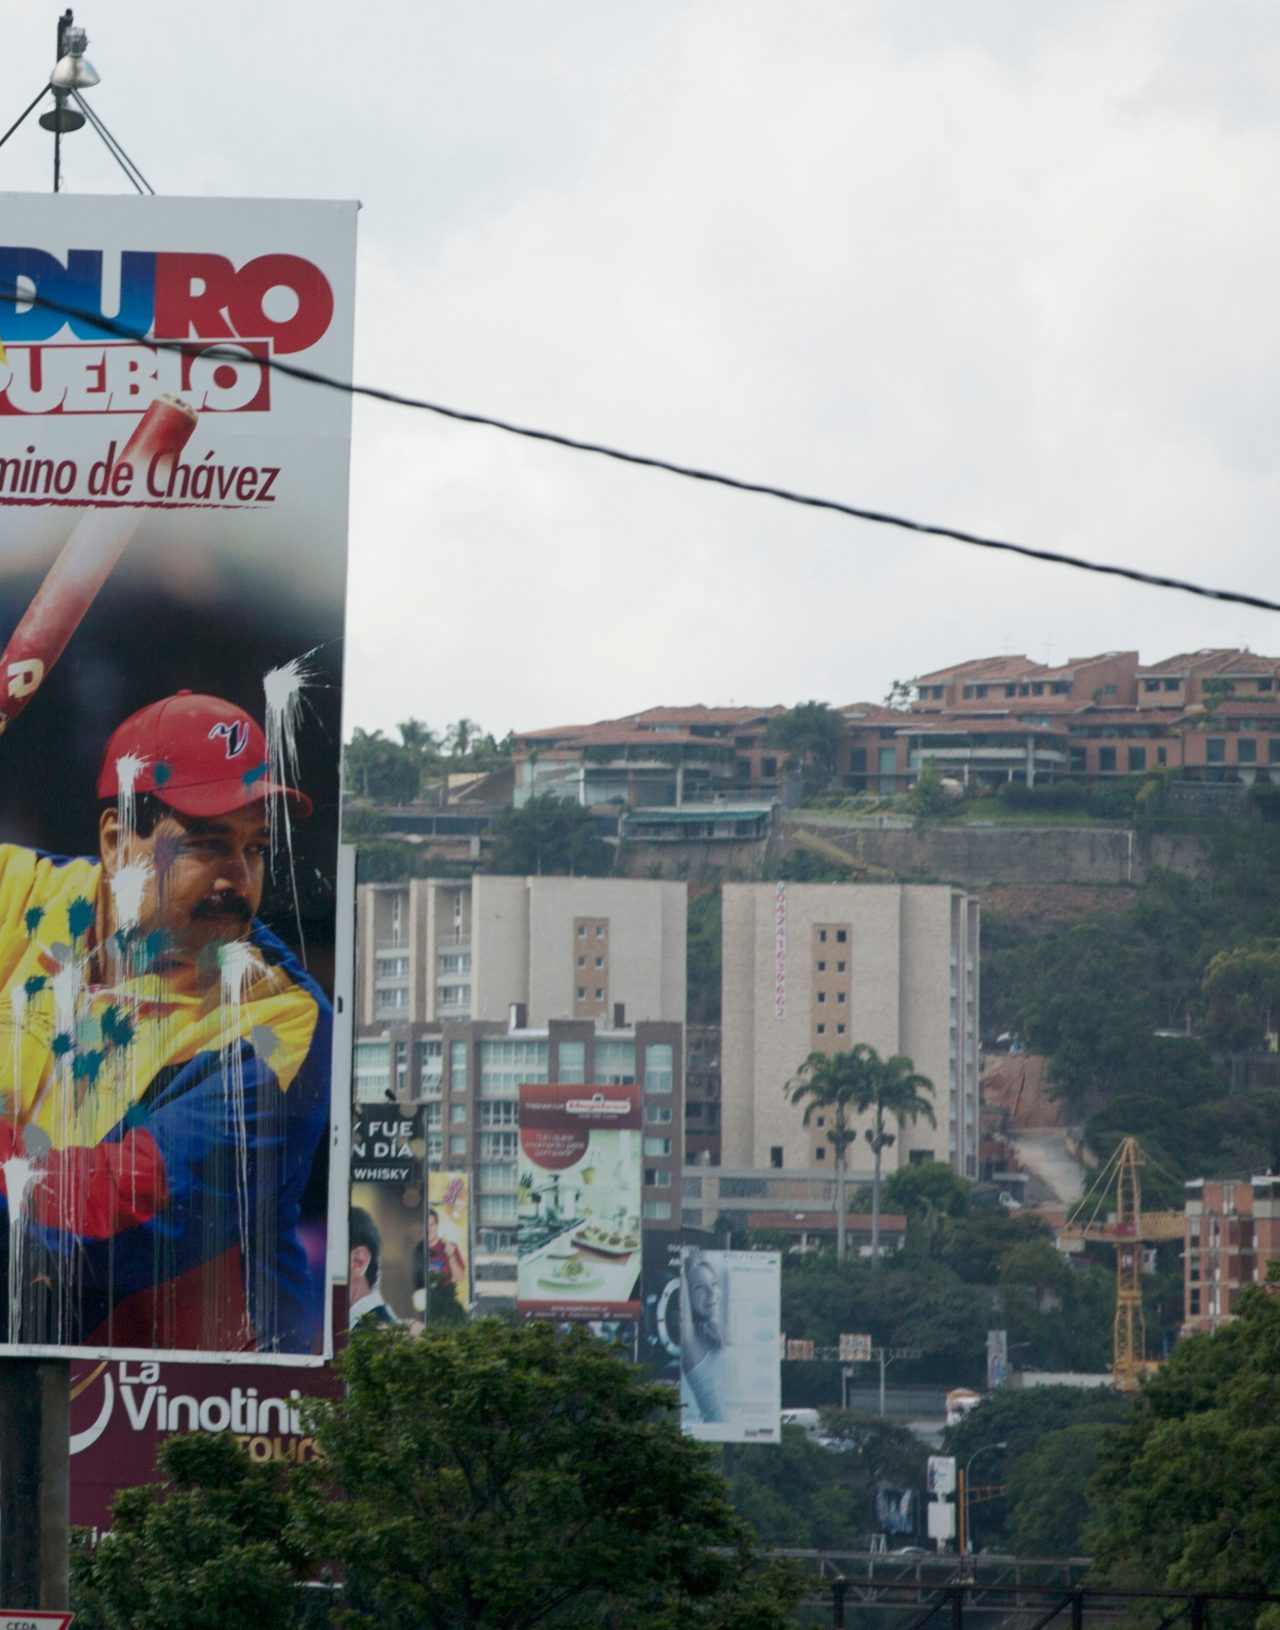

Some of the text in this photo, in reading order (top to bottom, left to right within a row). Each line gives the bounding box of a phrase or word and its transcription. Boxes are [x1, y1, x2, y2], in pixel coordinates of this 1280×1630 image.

[87, 440, 134, 497] de
[146, 449, 281, 501] Chávez
[368, 1121, 413, 1137] FUE
[374, 1137, 413, 1158] DÍA
[353, 1167, 409, 1180] WHISKY
[119, 1361, 160, 1384] La
[6, 1621, 37, 1630] CEDA
